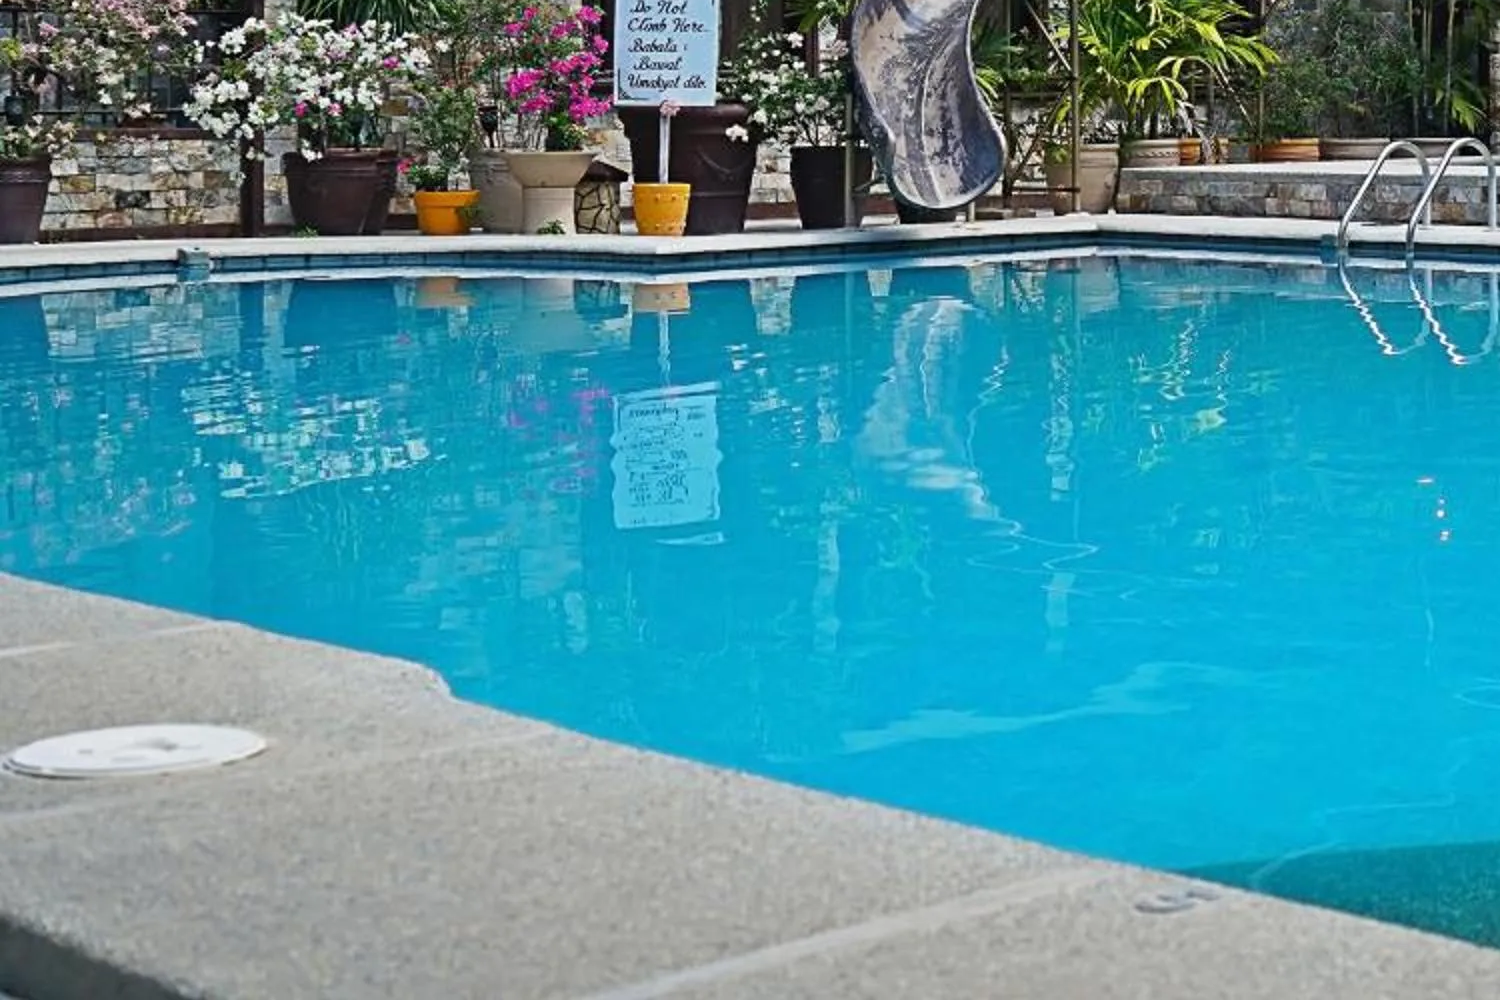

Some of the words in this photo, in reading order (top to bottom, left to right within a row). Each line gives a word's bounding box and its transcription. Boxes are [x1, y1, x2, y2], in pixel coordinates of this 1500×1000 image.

[630, 0, 651, 14] Do
[657, 0, 688, 14] Not
[628, 18, 667, 33] Climb
